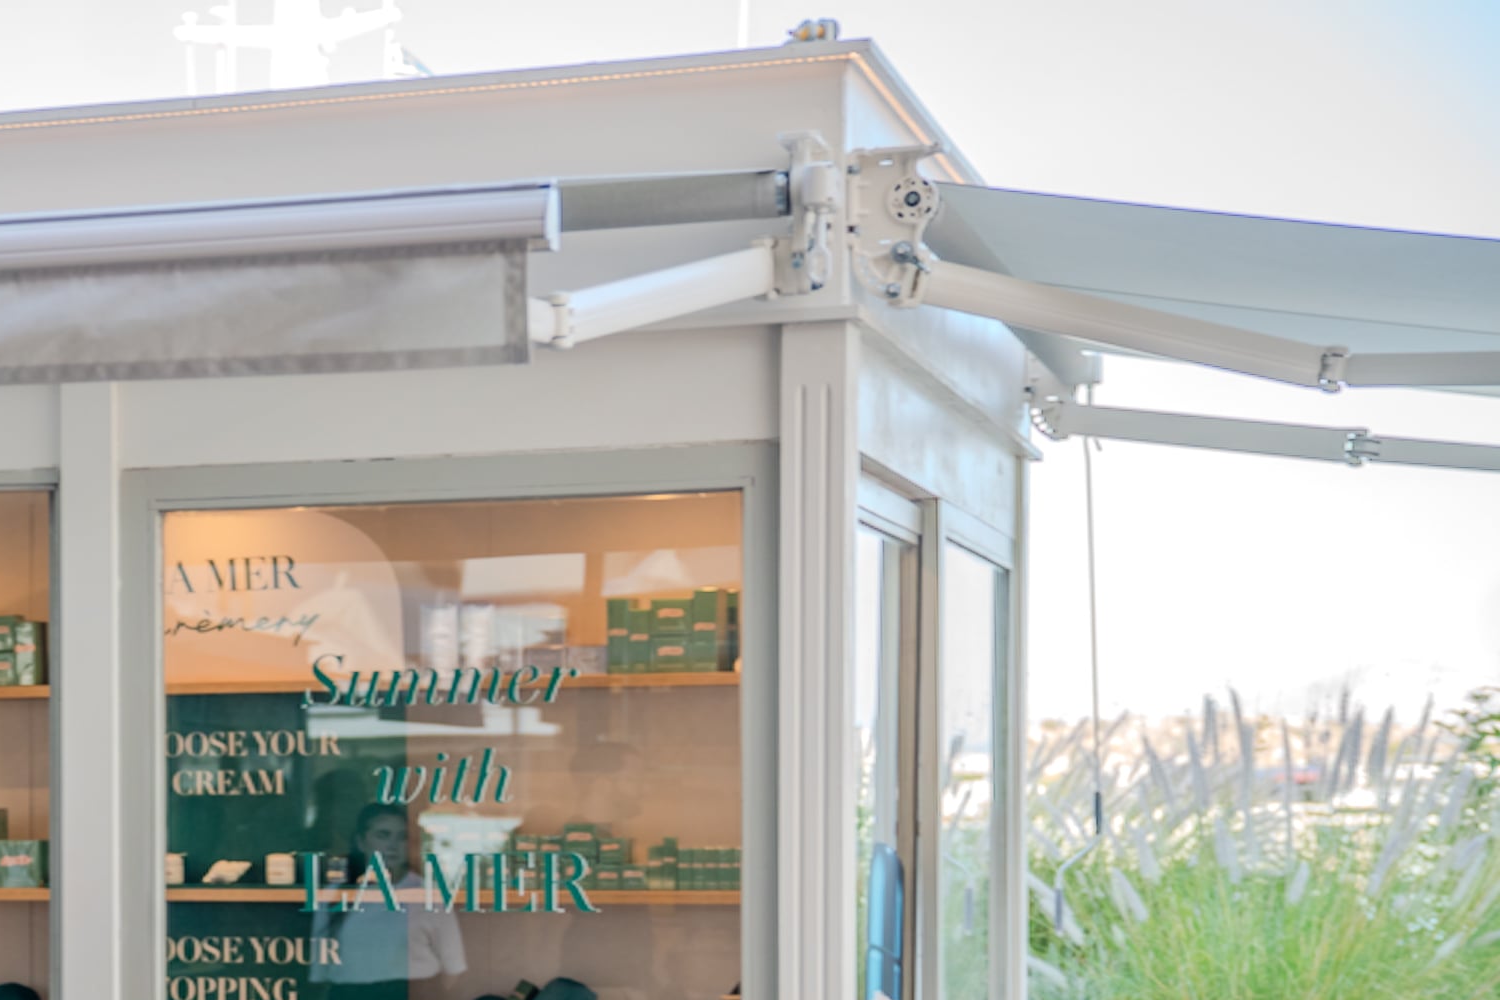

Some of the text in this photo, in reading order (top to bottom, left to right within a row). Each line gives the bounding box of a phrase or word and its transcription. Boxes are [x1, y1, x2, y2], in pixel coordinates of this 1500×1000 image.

[164, 555, 301, 594] A MER
[164, 609, 321, 647] rèmery
[301, 654, 580, 708] Summer
[164, 729, 341, 758] OOSE YOUR
[172, 769, 286, 796] CREAM
[373, 748, 514, 805] with
[300, 851, 602, 913] LA MER
[249, 936, 342, 966] YOUR
